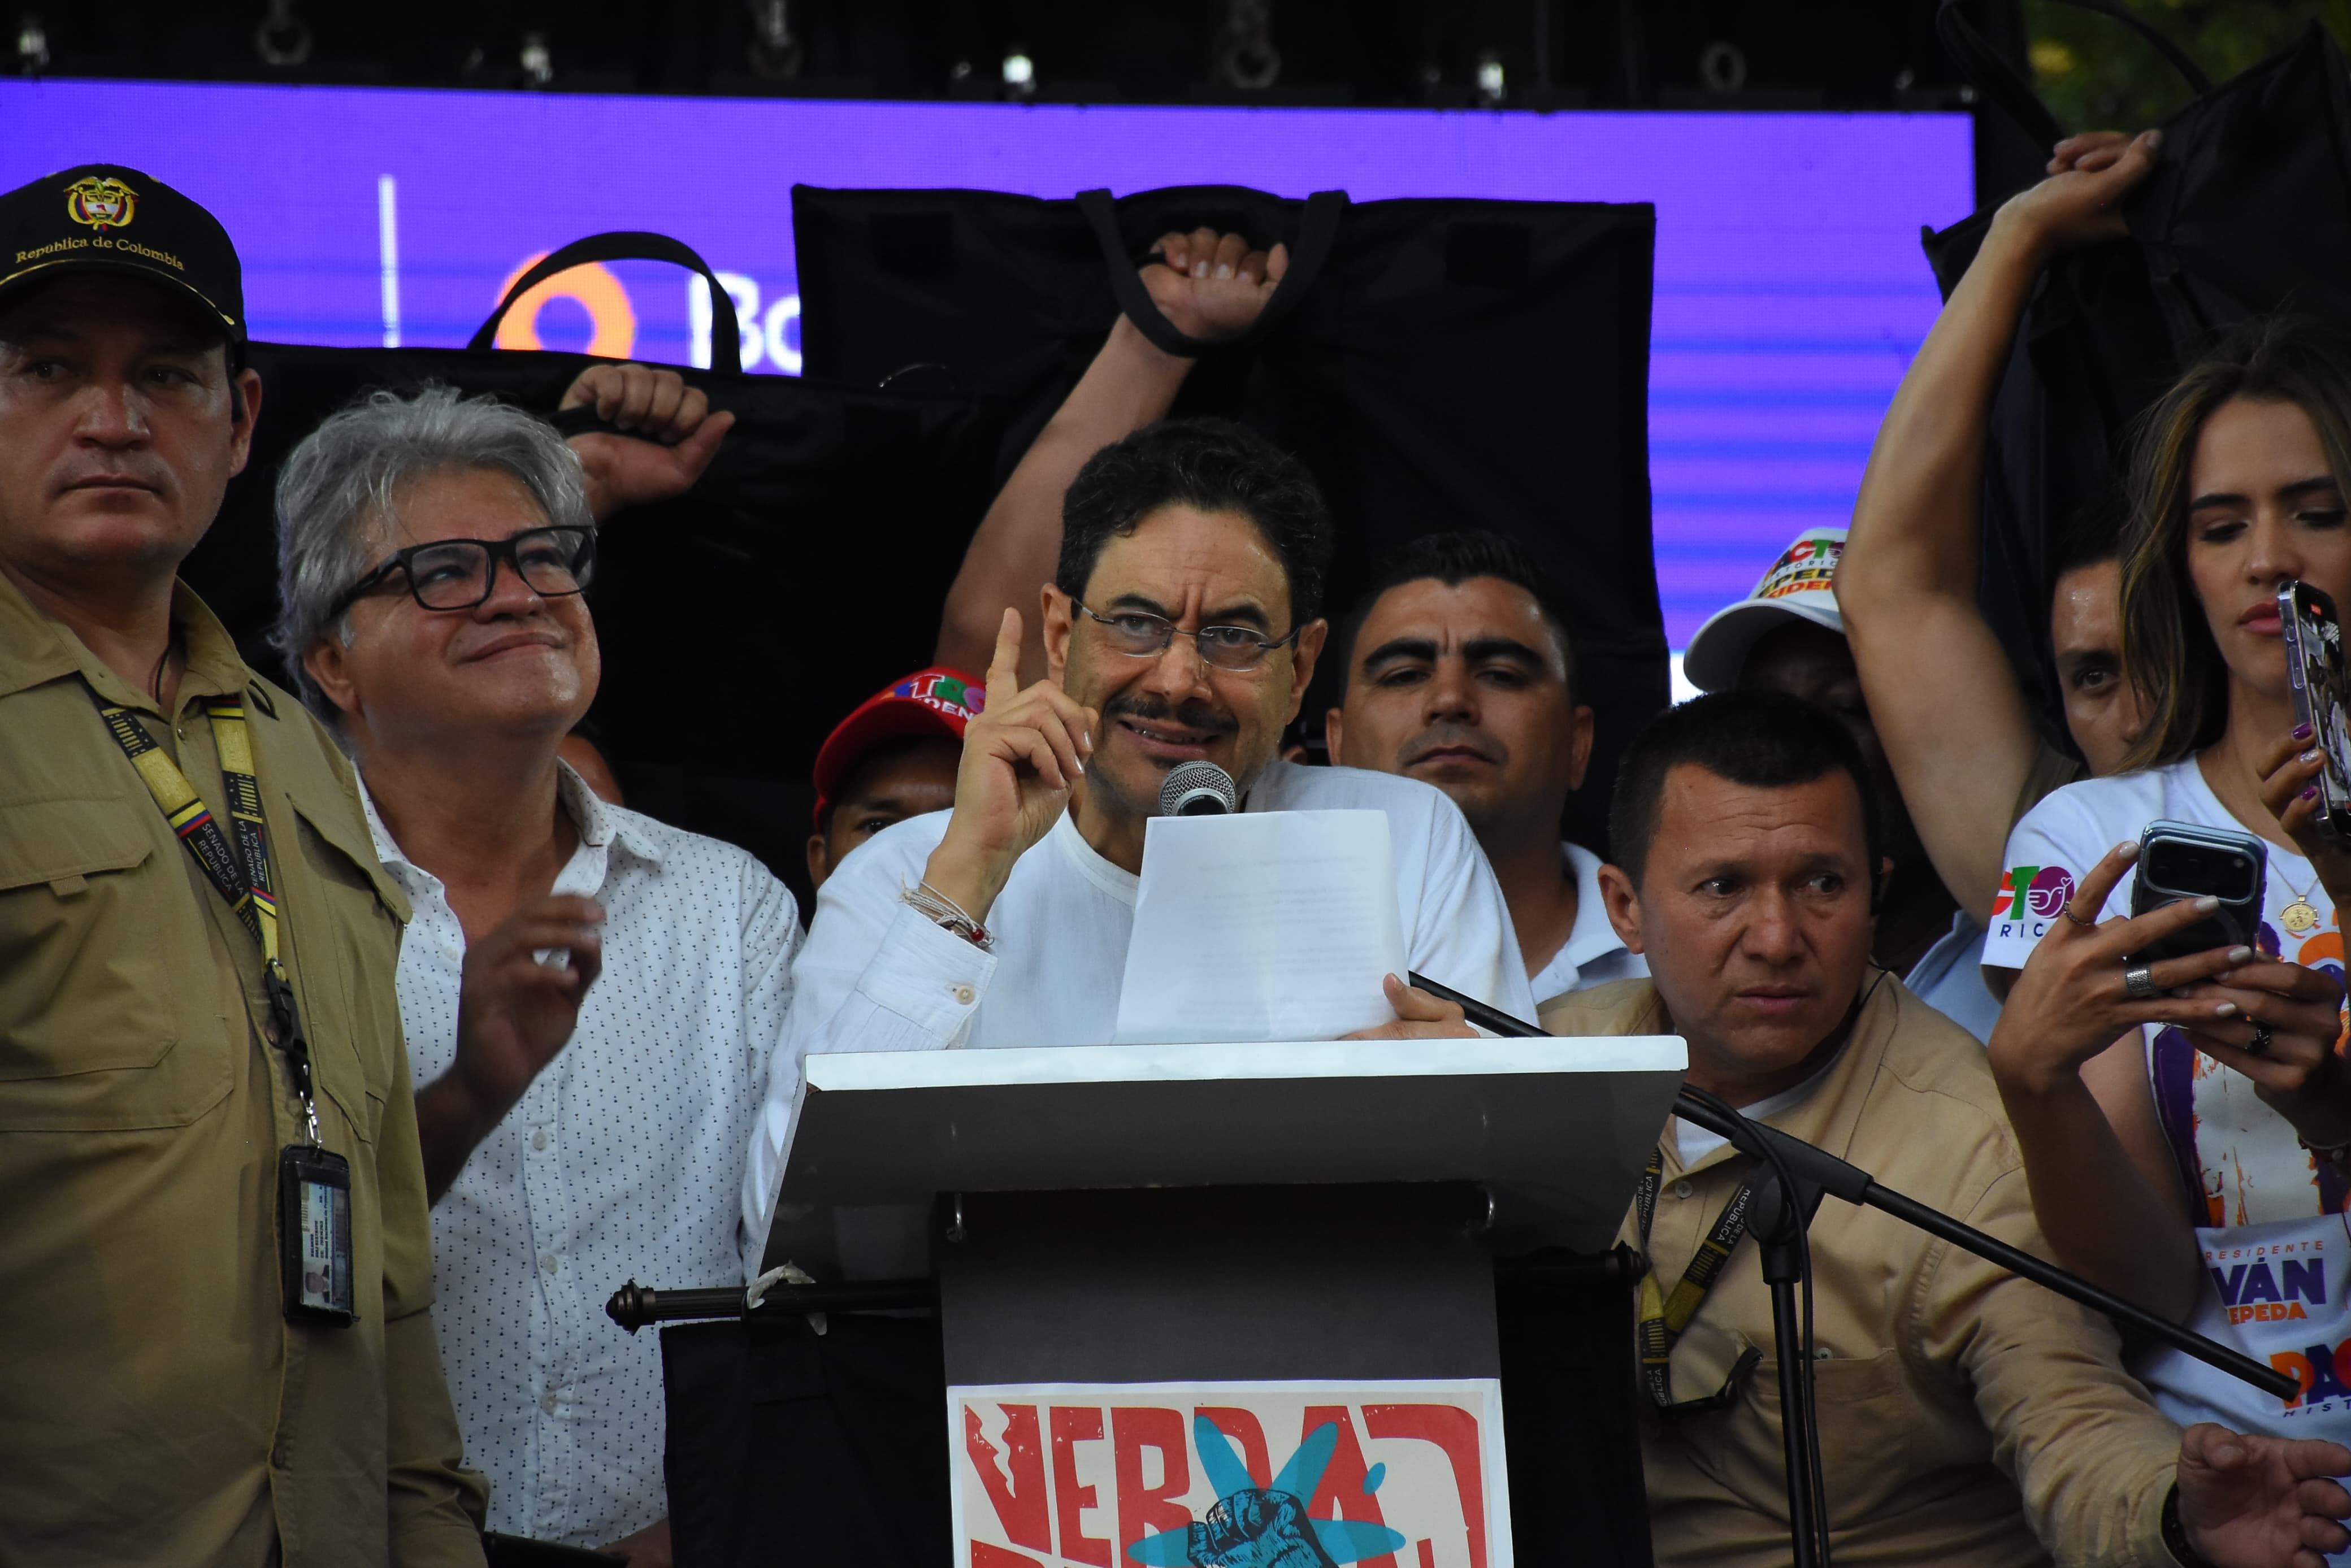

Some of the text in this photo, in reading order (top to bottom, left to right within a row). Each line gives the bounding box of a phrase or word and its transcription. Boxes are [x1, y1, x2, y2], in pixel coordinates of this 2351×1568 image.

[15, 236, 185, 271] Republica de Colombia
[202, 823, 244, 894] SENADO DE LA
[238, 820, 259, 887] SENADO DE LA
[2205, 1240, 2323, 1262] RESIDENTE
[2210, 1257, 2327, 1306] VÁN
[2228, 1302, 2307, 1325] EPEDA
